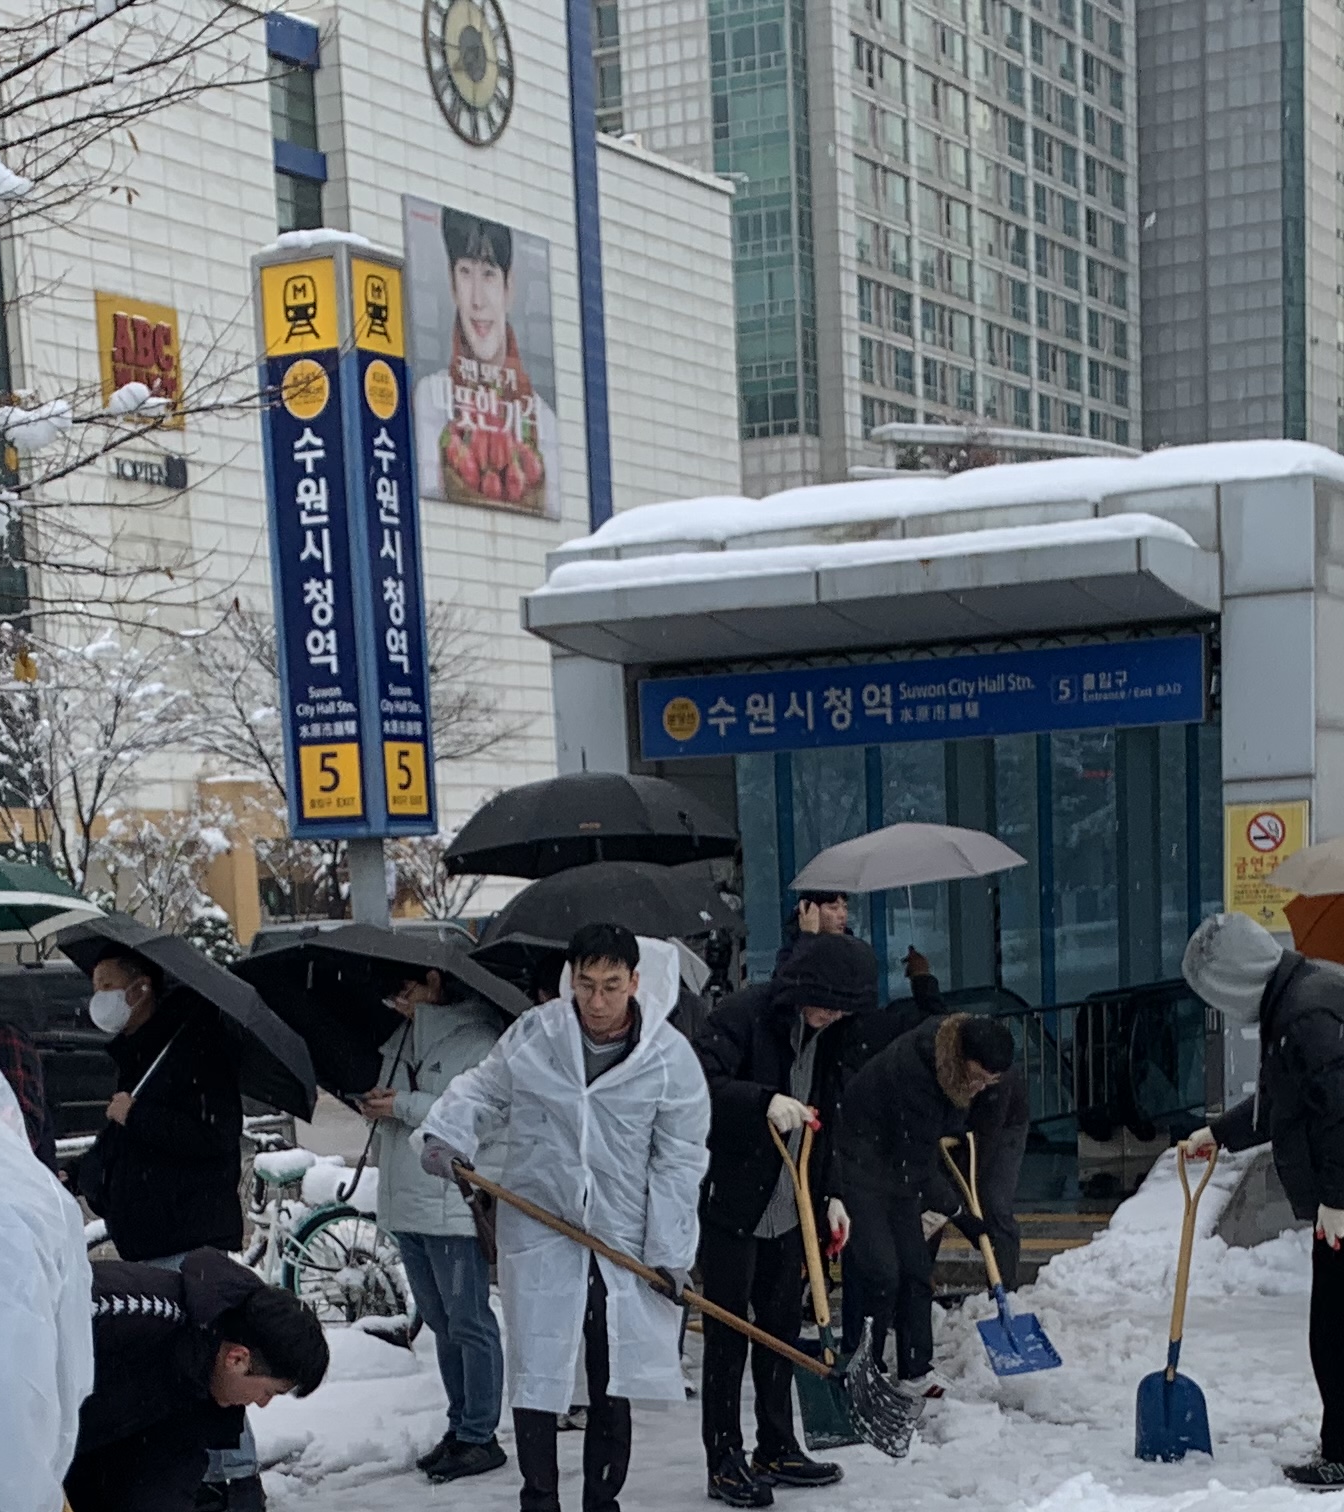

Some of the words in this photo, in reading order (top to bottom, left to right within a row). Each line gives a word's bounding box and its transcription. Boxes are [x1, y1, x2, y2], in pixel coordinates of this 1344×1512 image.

[112, 312, 174, 373] ABC
[294, 427, 338, 675] 수원시청역
[373, 427, 410, 675] 수원시청역
[308, 686, 342, 699] Suwon
[899, 681, 947, 700] Suwon
[948, 678, 974, 699] City
[978, 673, 1005, 693] Hall
[1008, 672, 1035, 691] Stn.
[1059, 679, 1071, 700] 5
[295, 704, 315, 718] City
[316, 701, 336, 715] Hall
[707, 684, 892, 737] 수원시청역
[320, 751, 340, 793] 5
[398, 750, 412, 790] 5
